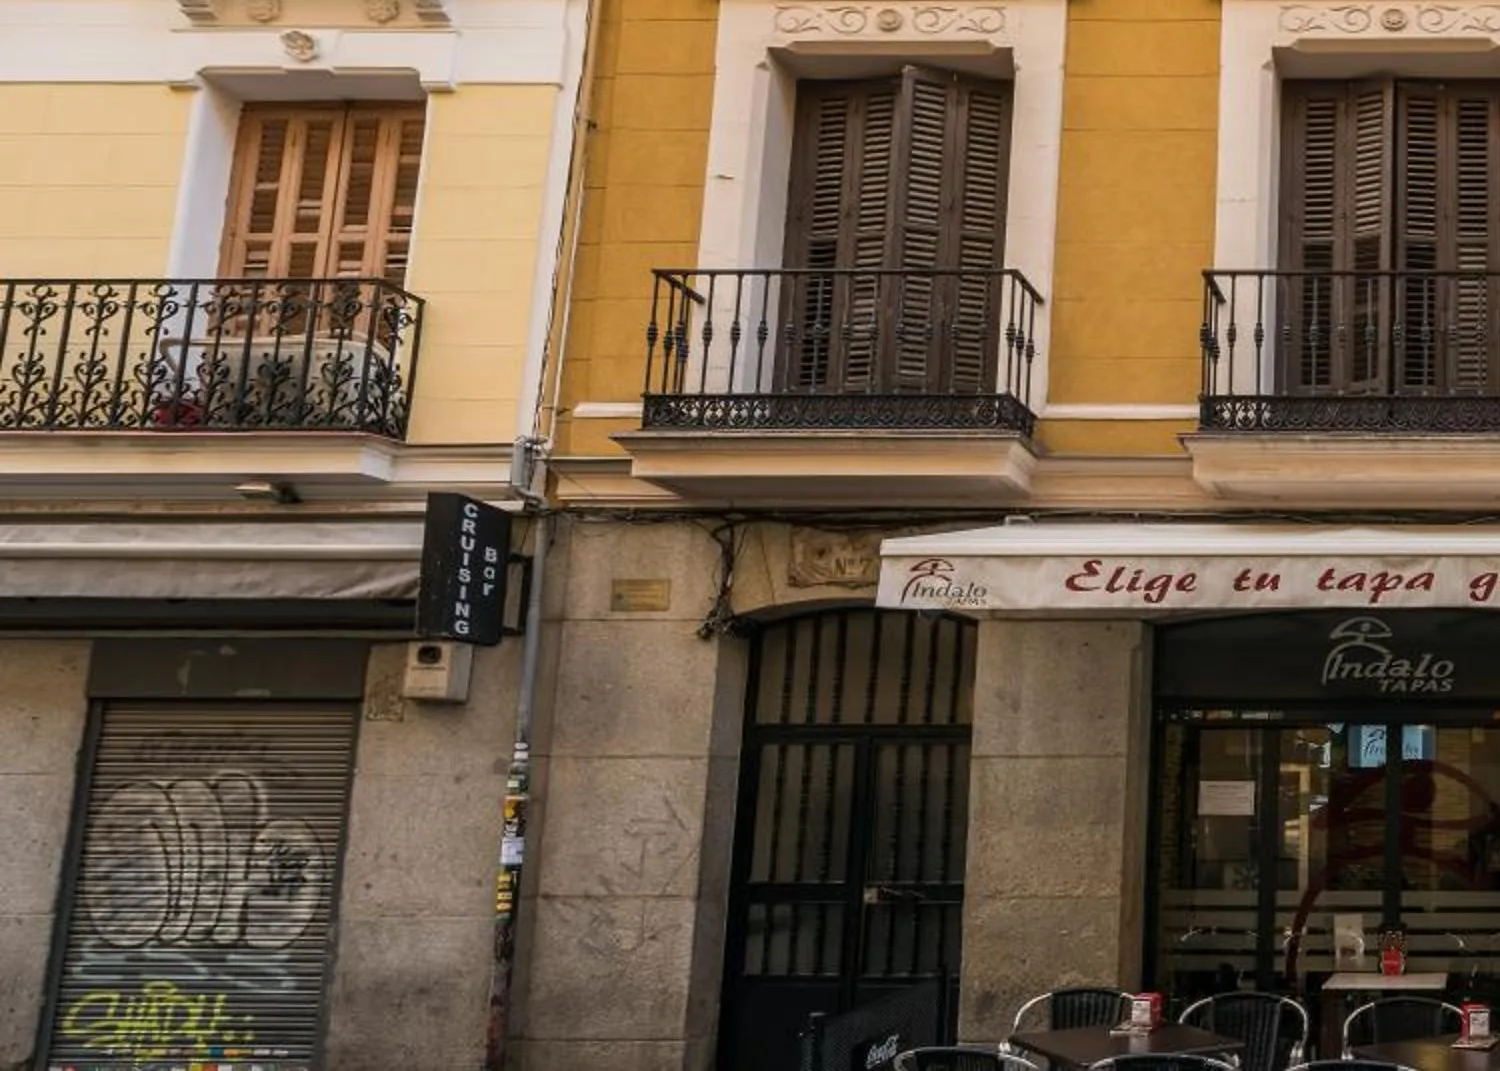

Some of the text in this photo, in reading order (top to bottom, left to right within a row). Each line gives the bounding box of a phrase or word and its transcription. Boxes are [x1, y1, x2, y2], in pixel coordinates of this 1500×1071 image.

[455, 503, 479, 635] CRUISING
[483, 547, 497, 596] Bar
[1065, 558, 1197, 604] Elige
[1233, 568, 1281, 591] tu
[1316, 567, 1435, 603] tapa
[911, 581, 988, 599] Indalo
[1328, 654, 1455, 680] Indalo
[1378, 678, 1455, 693] TAPAS
